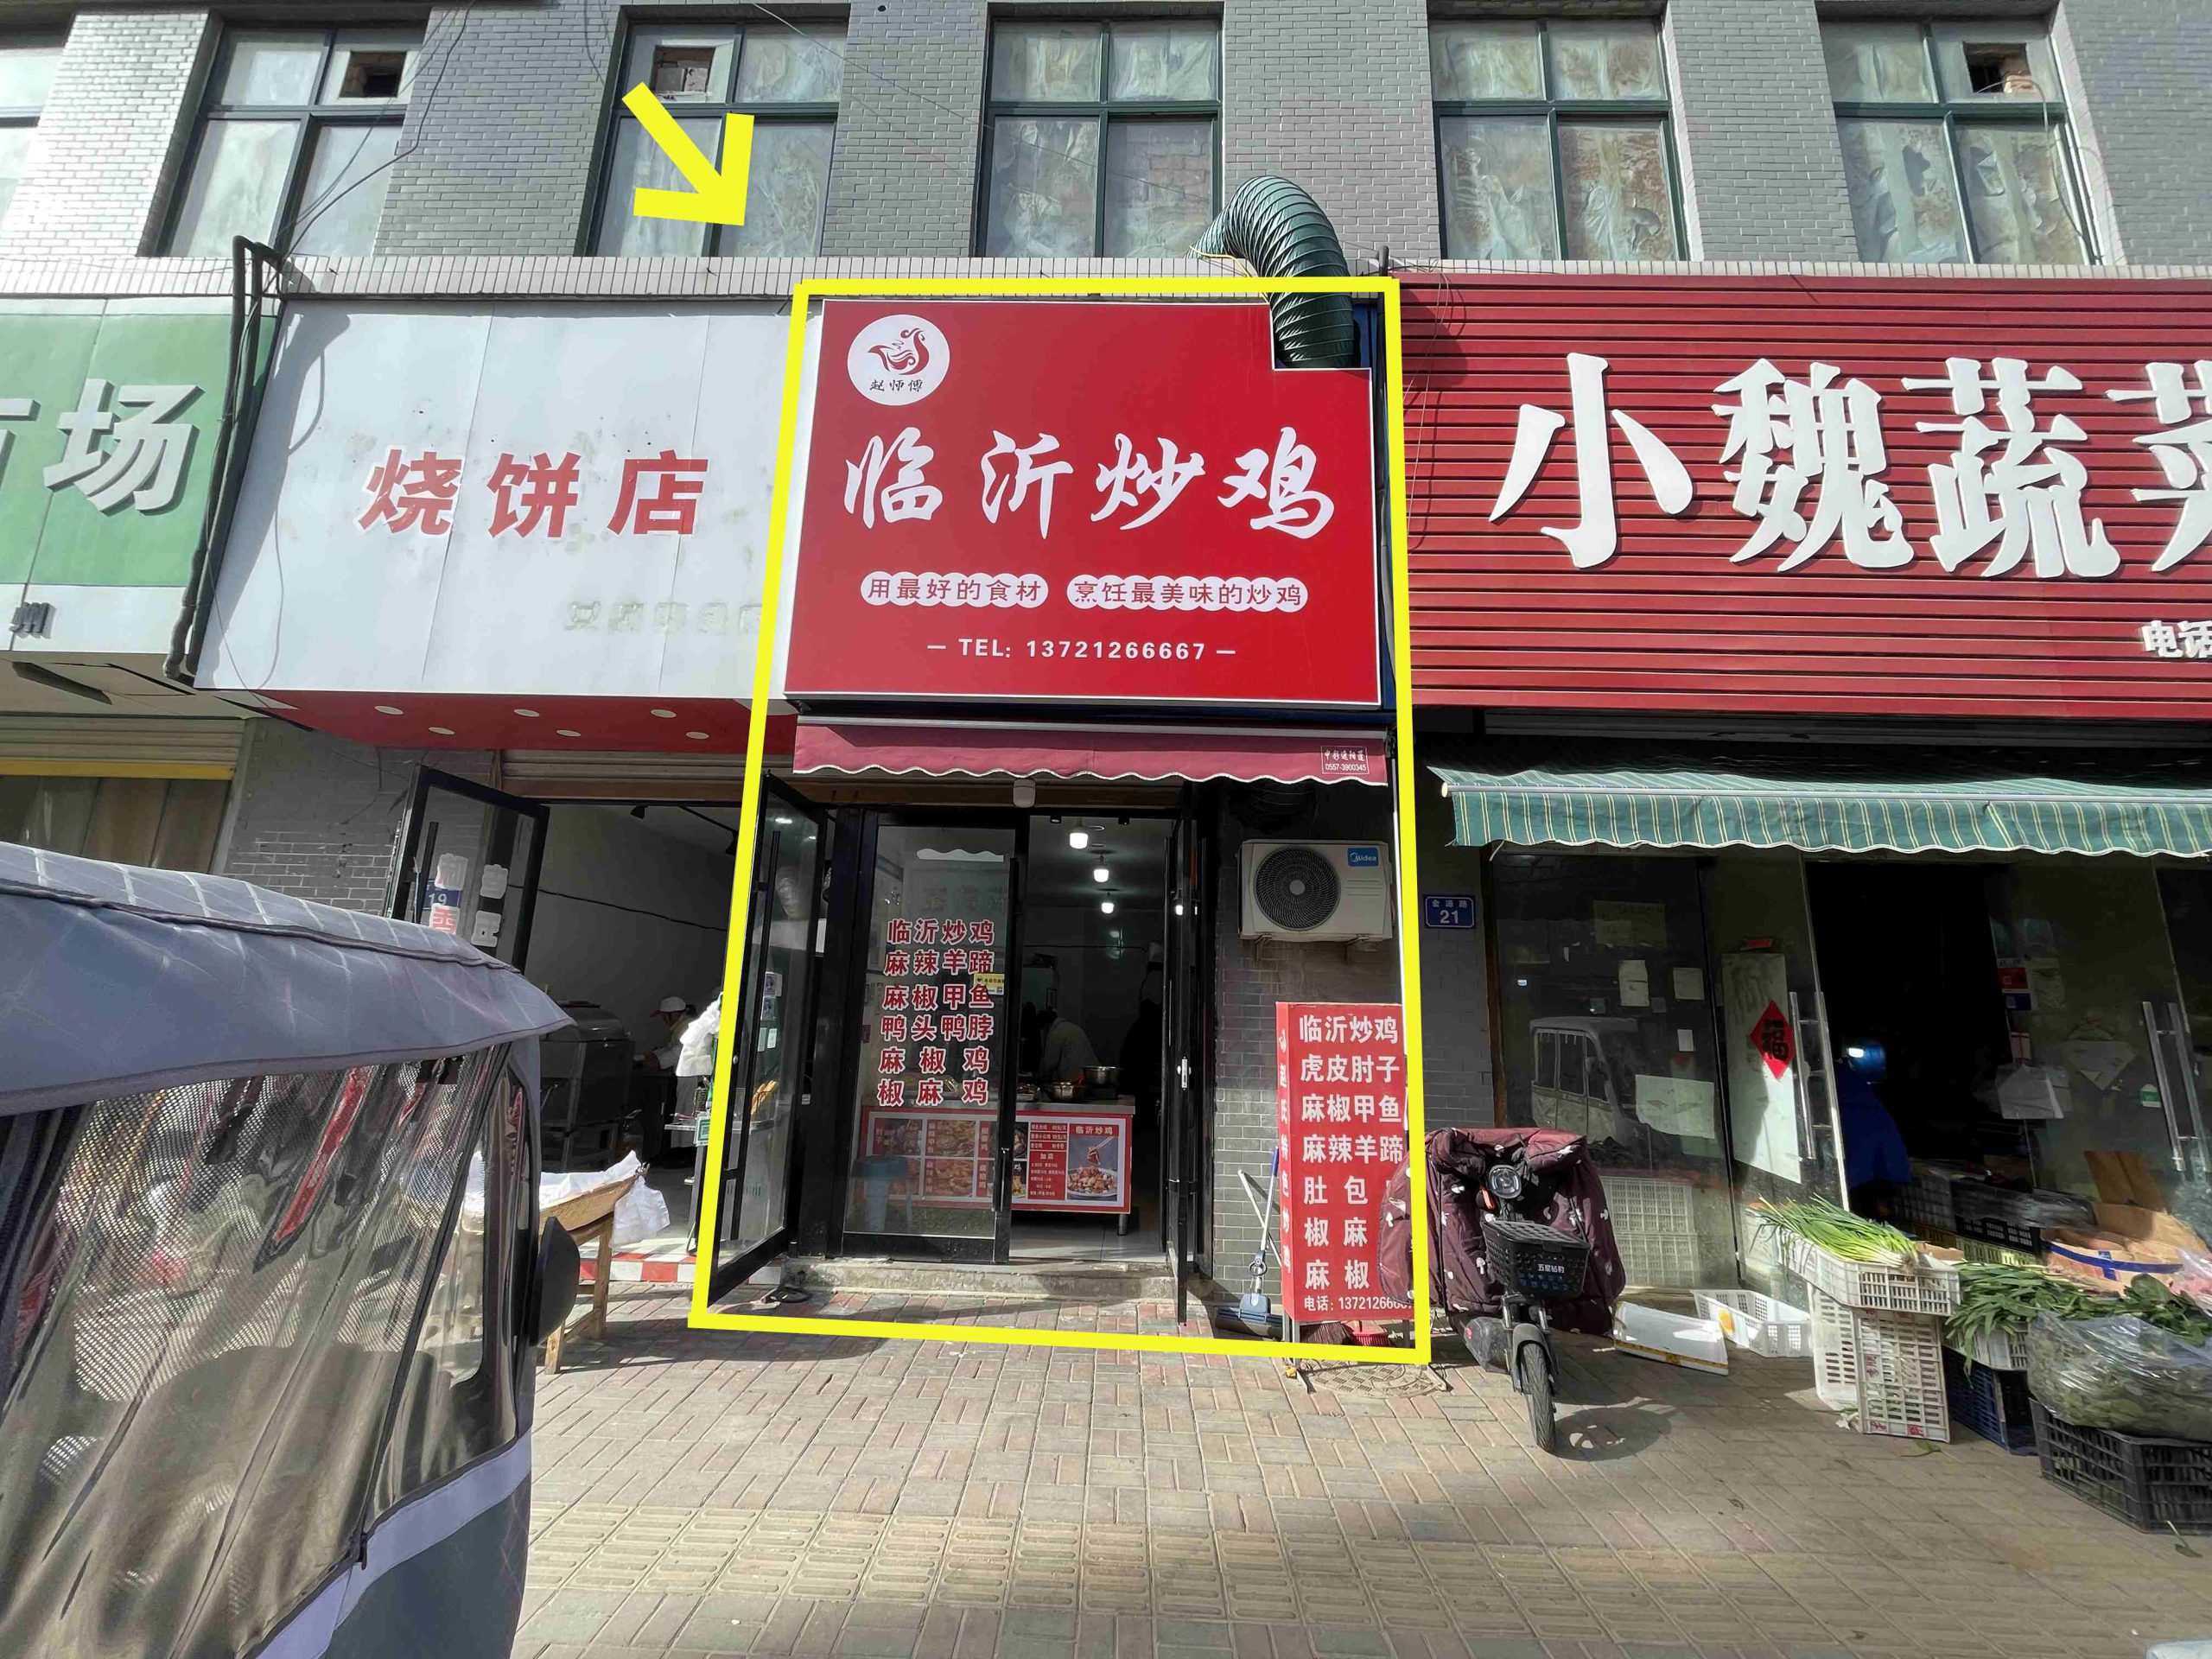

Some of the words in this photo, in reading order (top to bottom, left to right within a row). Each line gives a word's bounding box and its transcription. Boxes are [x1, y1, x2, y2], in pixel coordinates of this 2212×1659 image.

[869, 378, 924, 392] 赵师傅
[0, 378, 204, 515] 场
[358, 447, 710, 538] 烧饼店
[843, 426, 1335, 539] 临沂炒鸡
[868, 578, 1042, 604] 用最好的食材
[1073, 579, 1303, 607] 烹饪最美味的炒鸡
[959, 638, 1012, 659] TEL:
[1026, 639, 1207, 661] 13721266667
[428, 893, 448, 906] 19
[1440, 909, 1459, 924] 21
[887, 918, 995, 945] 临沂炒鸡
[884, 948, 995, 976] 麻辣羊蹄
[882, 982, 994, 1011] 麻椒甲鱼
[880, 1014, 995, 1043] 鸭头鸭脖
[1299, 1014, 1398, 1044] 临沂炒鸡
[1300, 1053, 1401, 1084] 虎皮肘子
[1301, 1093, 1402, 1123] 麻椒甲鱼
[1075, 1125, 1113, 1135] 临沂炒鸡
[1302, 1134, 1403, 1165] 麻辣羊蹄
